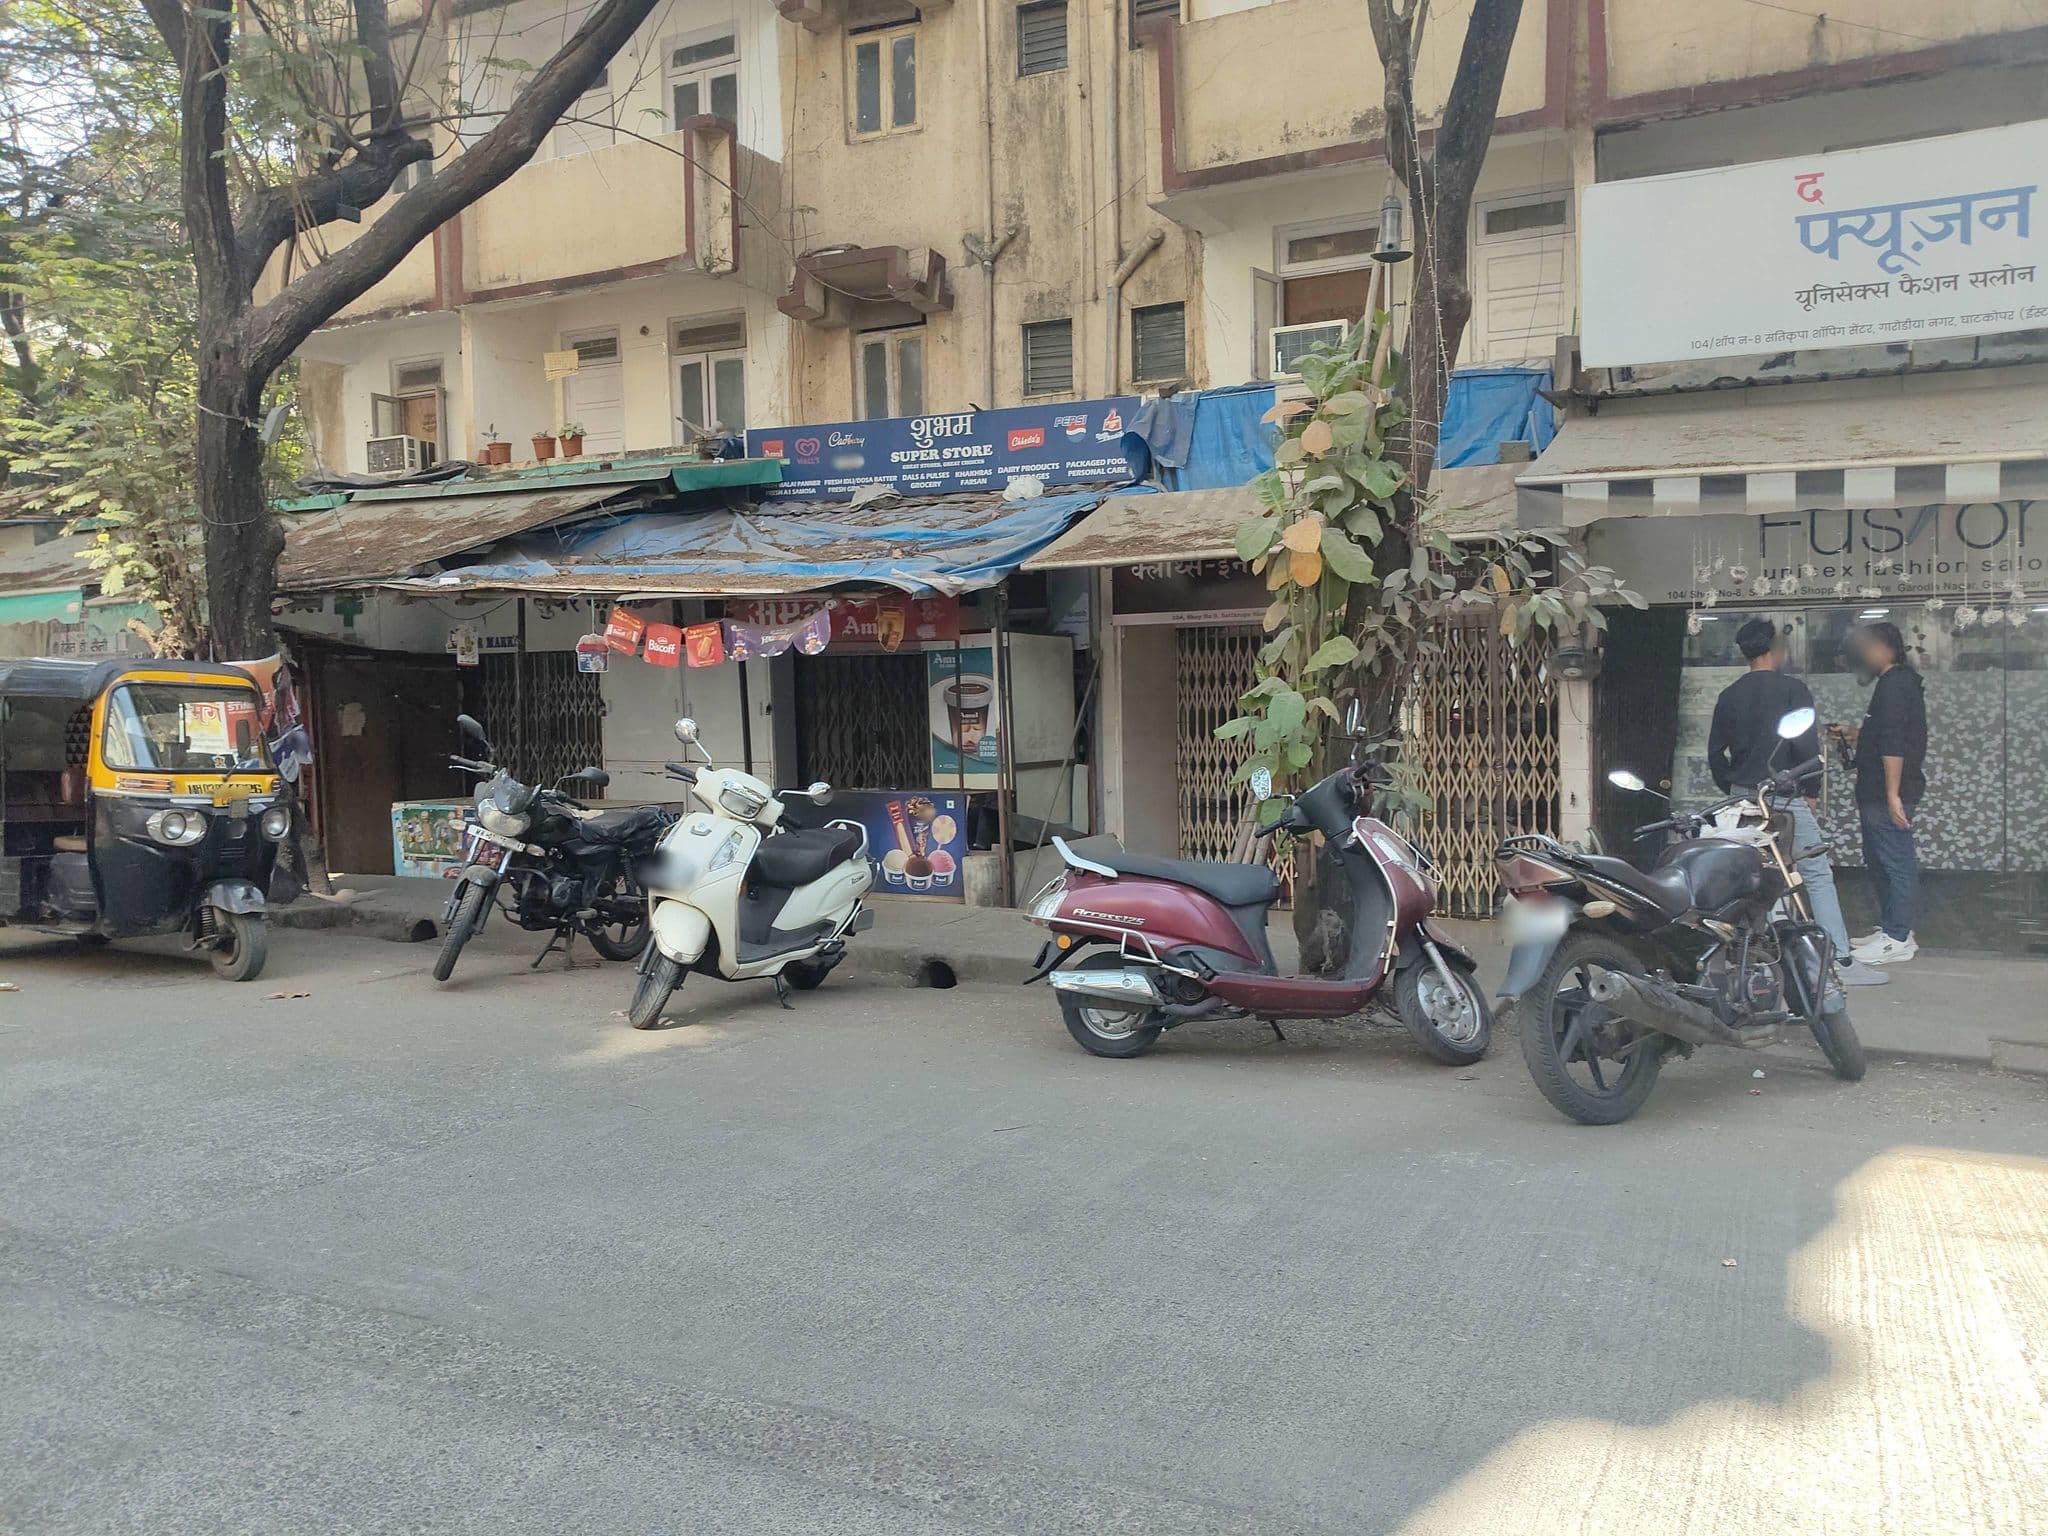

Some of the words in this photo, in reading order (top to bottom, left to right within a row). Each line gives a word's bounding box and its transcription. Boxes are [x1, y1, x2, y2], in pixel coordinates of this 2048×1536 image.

[1794, 172, 1825, 206] द
[1794, 185, 2038, 274] फ्यूज़न
[1795, 281, 1890, 312] यूनिसेक्स
[1899, 273, 1960, 296] फैशन
[1969, 263, 2037, 289] सलोन
[1053, 414, 1088, 427] PEPSI
[828, 431, 865, 448] Cadbury
[910, 414, 975, 449] शुभम
[890, 449, 940, 463] SUPER
[942, 444, 993, 460] STORE
[1020, 462, 1060, 472] PRODUCTS
[1066, 458, 1106, 468] PACKAGED
[1067, 469, 1105, 477] PERSONAL
[1106, 466, 1127, 474] CARE
[926, 471, 951, 479] PULSES
[1007, 472, 1051, 482] BEVGES
[1981, 555, 2048, 573] salo
[648, 638, 677, 656] Biscoff
